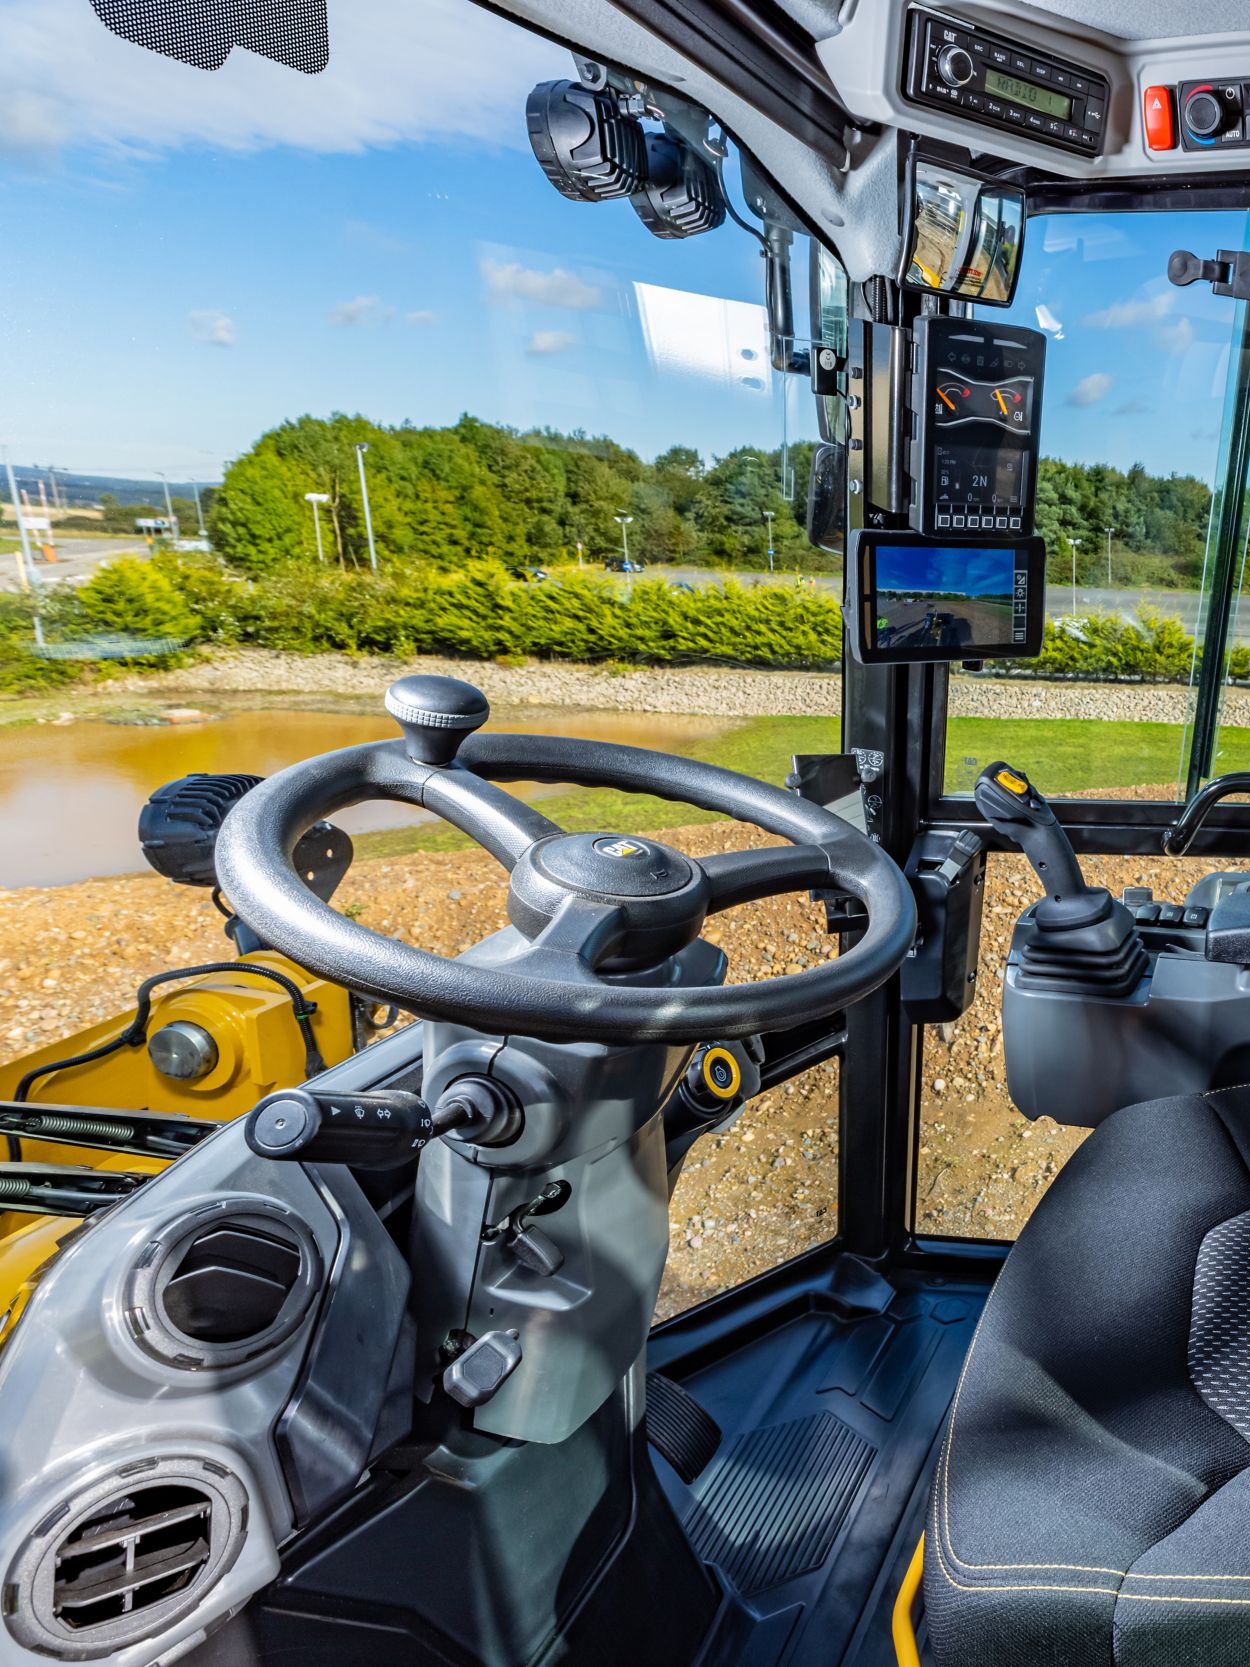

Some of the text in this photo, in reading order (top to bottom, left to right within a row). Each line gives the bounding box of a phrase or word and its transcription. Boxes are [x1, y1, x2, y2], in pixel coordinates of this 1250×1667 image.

[943, 30, 957, 42] CAT
[974, 44, 984, 52] SRC
[997, 76, 1038, 102] RADIO
[1225, 130, 1240, 138] AUTO
[972, 475, 988, 487] 2N
[602, 840, 639, 857] CAT
